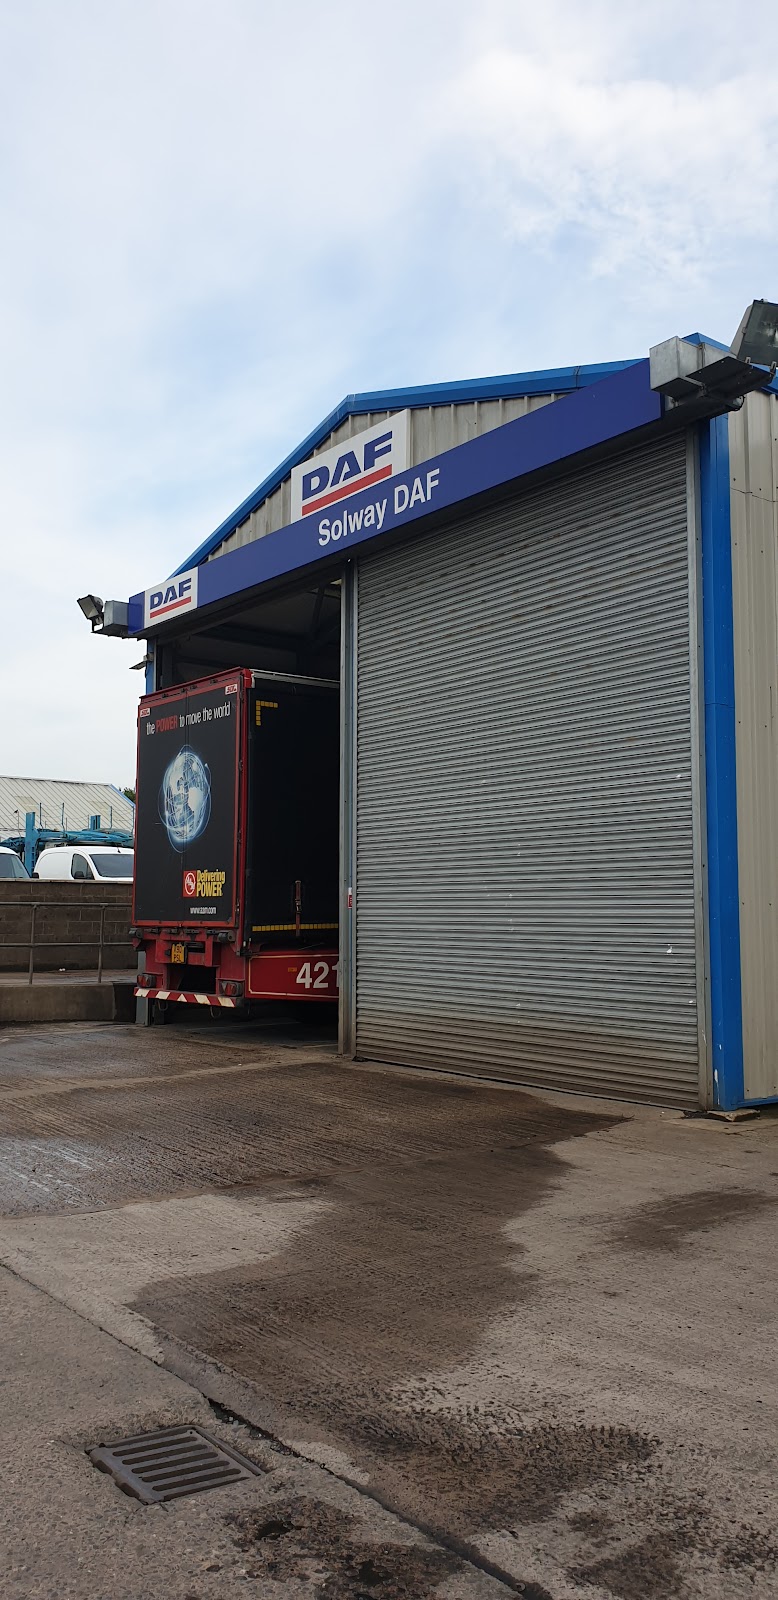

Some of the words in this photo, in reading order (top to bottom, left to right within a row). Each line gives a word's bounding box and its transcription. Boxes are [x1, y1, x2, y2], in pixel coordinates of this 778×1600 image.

[302, 430, 393, 501] DAF
[318, 498, 387, 546] Solway
[394, 468, 440, 515] DAF
[150, 577, 192, 610] DAF
[146, 721, 156, 735] the
[156, 715, 178, 733] POWER
[179, 714, 185, 728] to
[185, 711, 202, 726] move
[202, 706, 212, 722] the
[213, 701, 231, 719] world
[197, 869, 226, 885] Delivering
[197, 882, 222, 897] POWER
